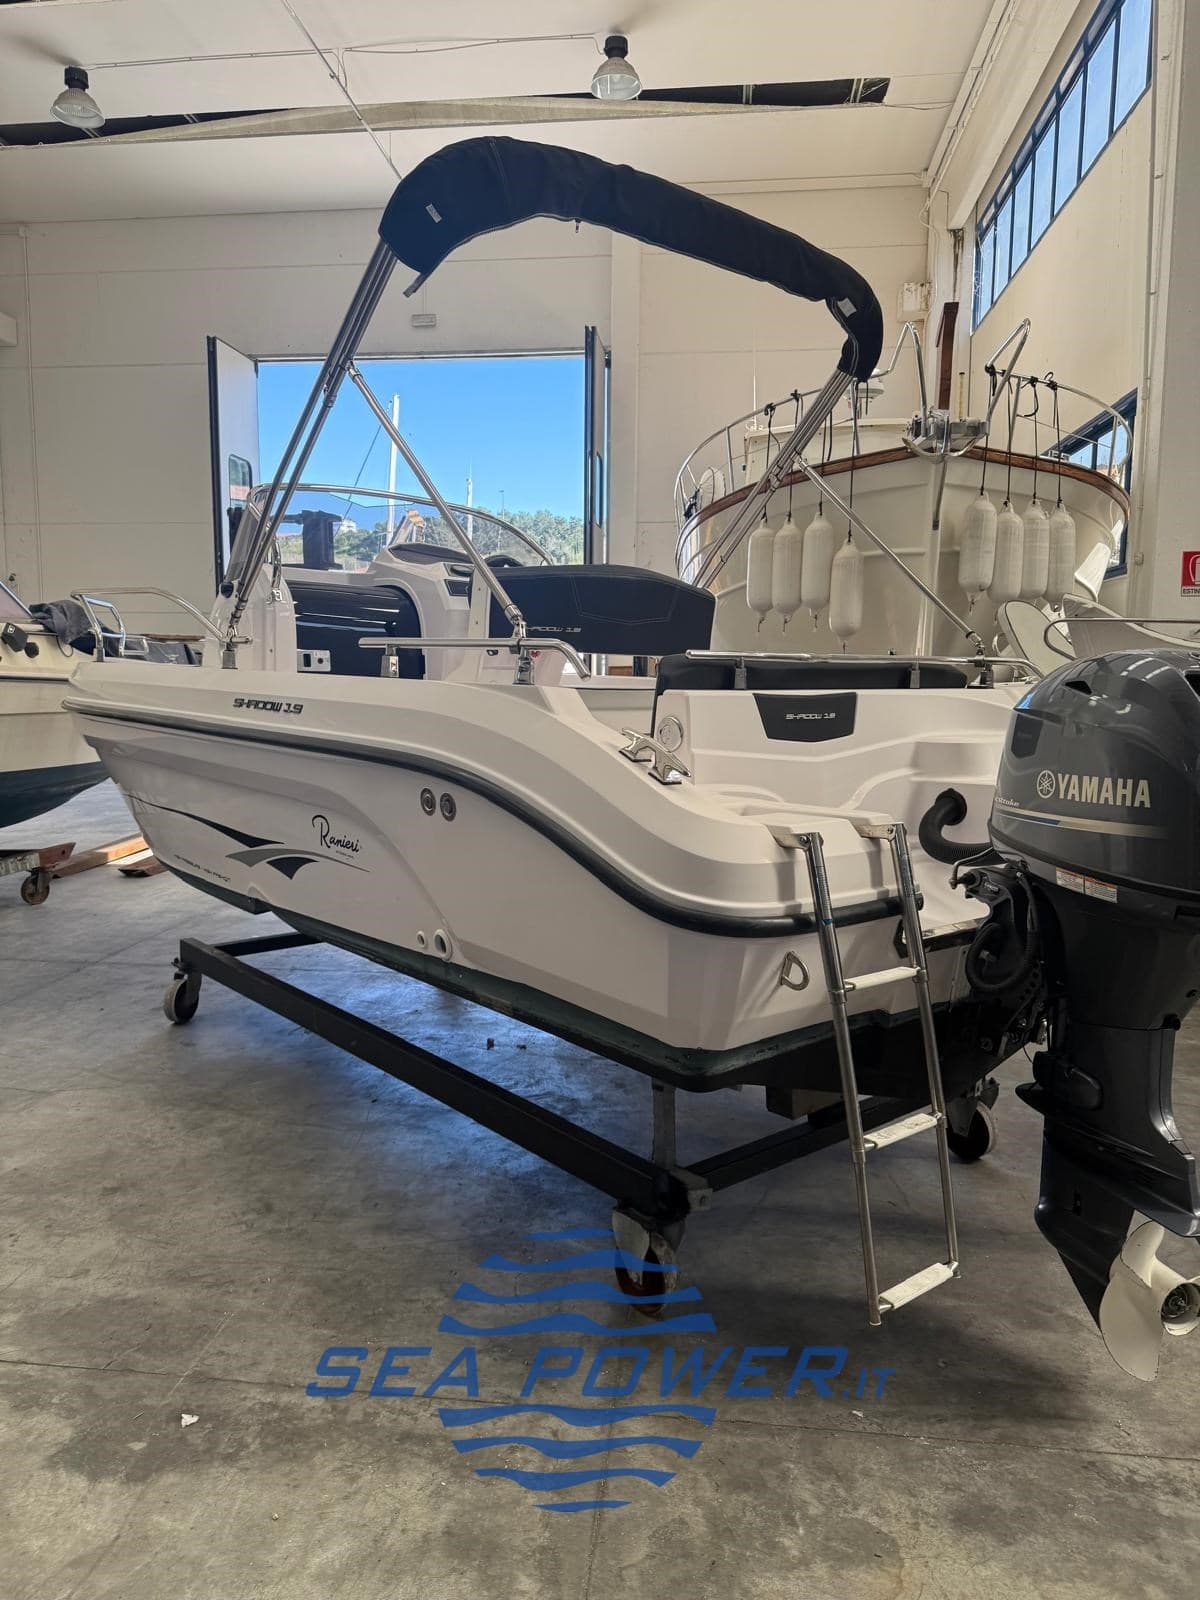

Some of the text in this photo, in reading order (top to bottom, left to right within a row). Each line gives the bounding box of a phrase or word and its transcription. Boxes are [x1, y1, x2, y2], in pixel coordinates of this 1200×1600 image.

[233, 698, 283, 712] SHADOW
[1057, 773, 1151, 808] YAMAHA
[311, 814, 360, 853] Ranieri
